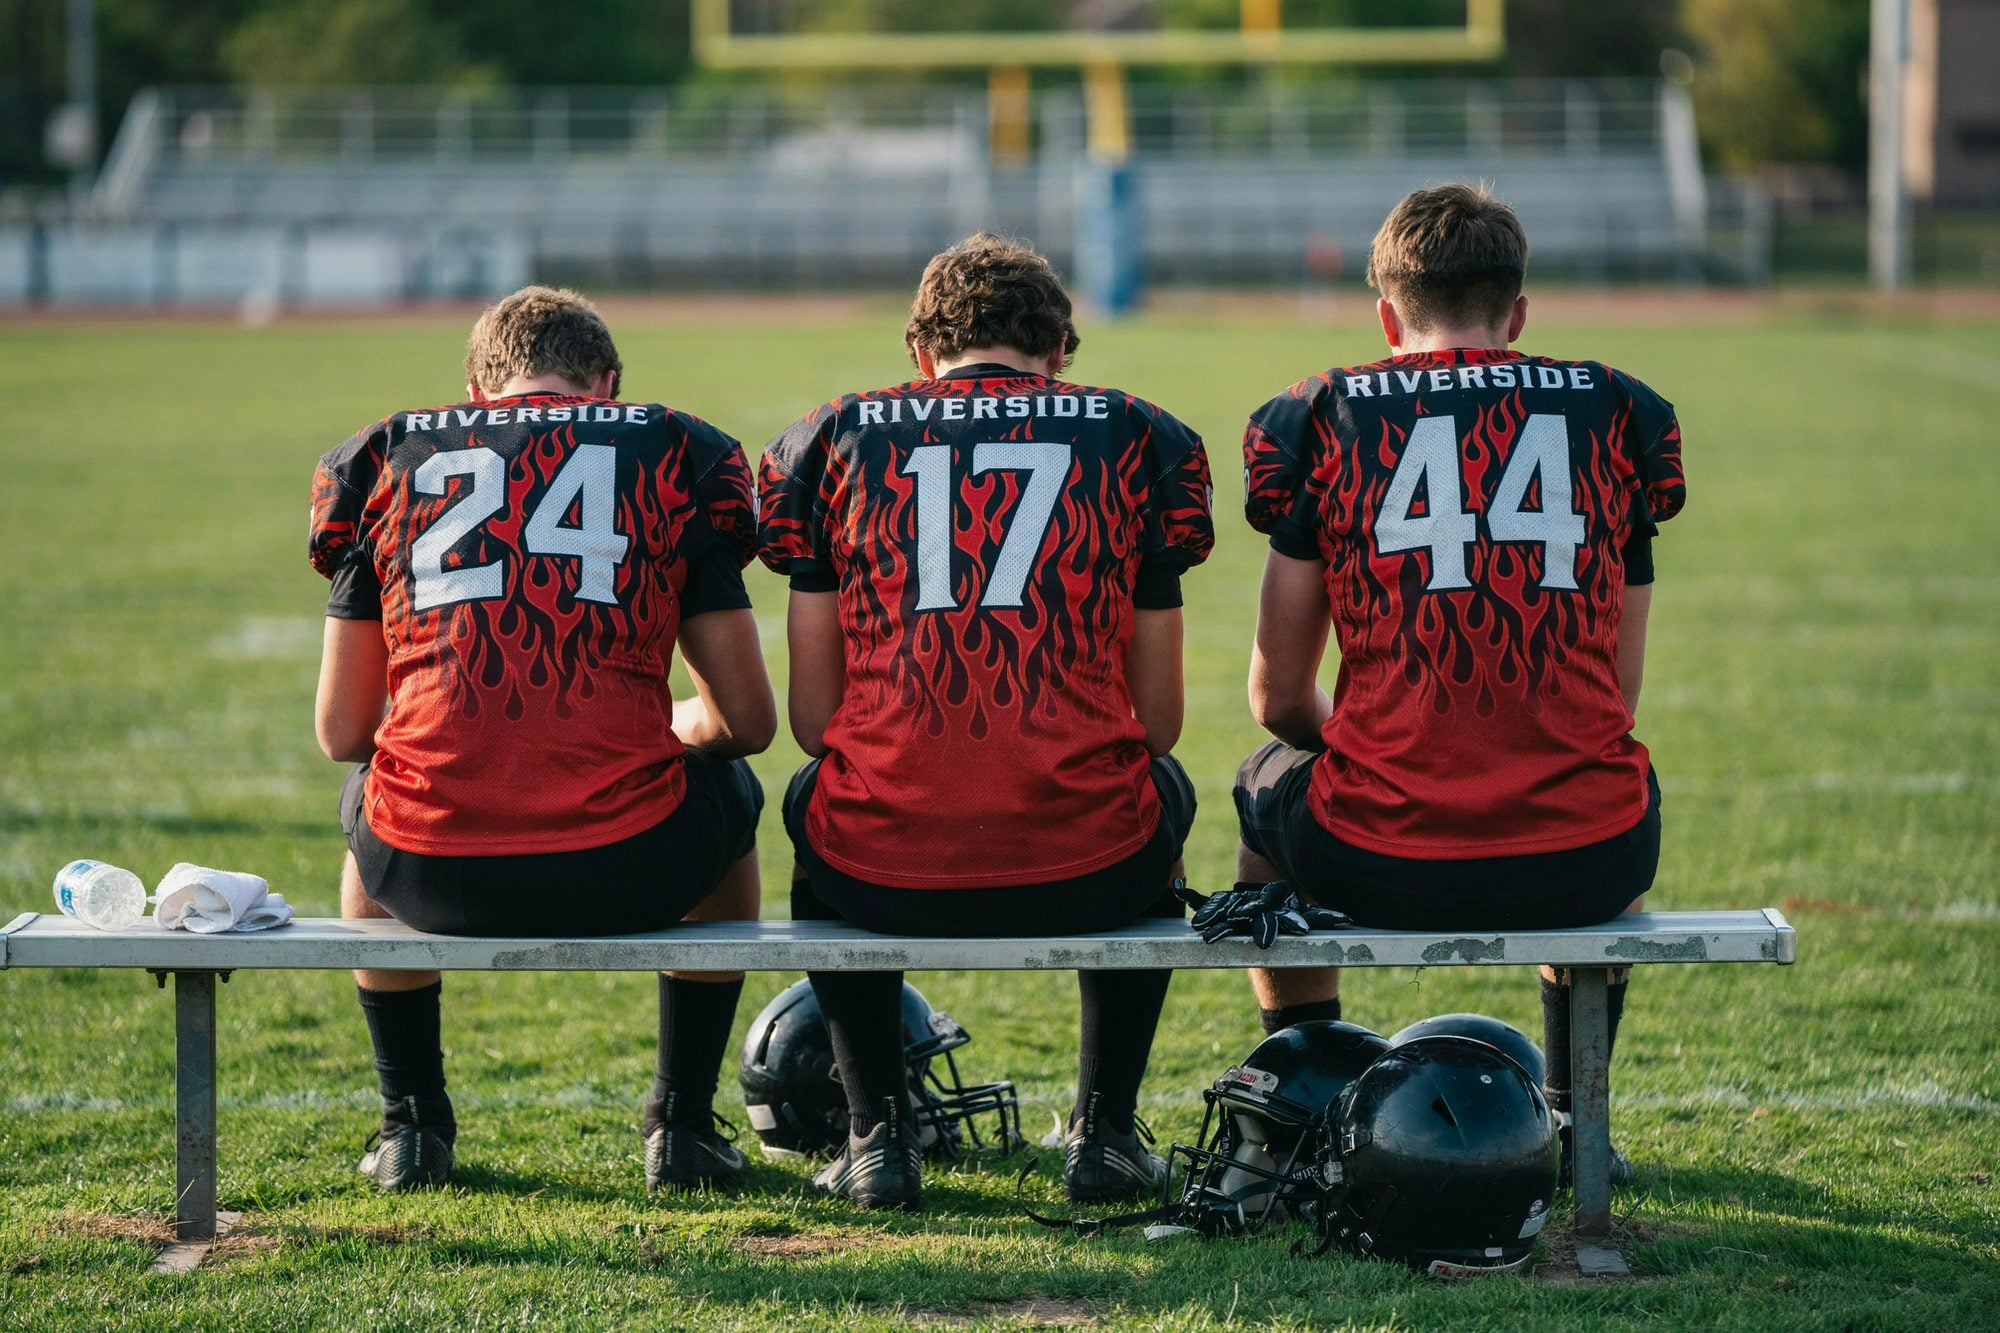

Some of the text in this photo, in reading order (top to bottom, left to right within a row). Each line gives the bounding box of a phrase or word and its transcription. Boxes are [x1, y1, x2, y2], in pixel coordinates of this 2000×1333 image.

[405, 405, 649, 433] RIVERSIDE
[857, 395, 1110, 426] RIVERSIDE
[1346, 364, 1595, 398] RIVERSIDE
[411, 443, 629, 612] 24
[901, 442, 1072, 611] 17
[1374, 413, 1586, 591] 44
